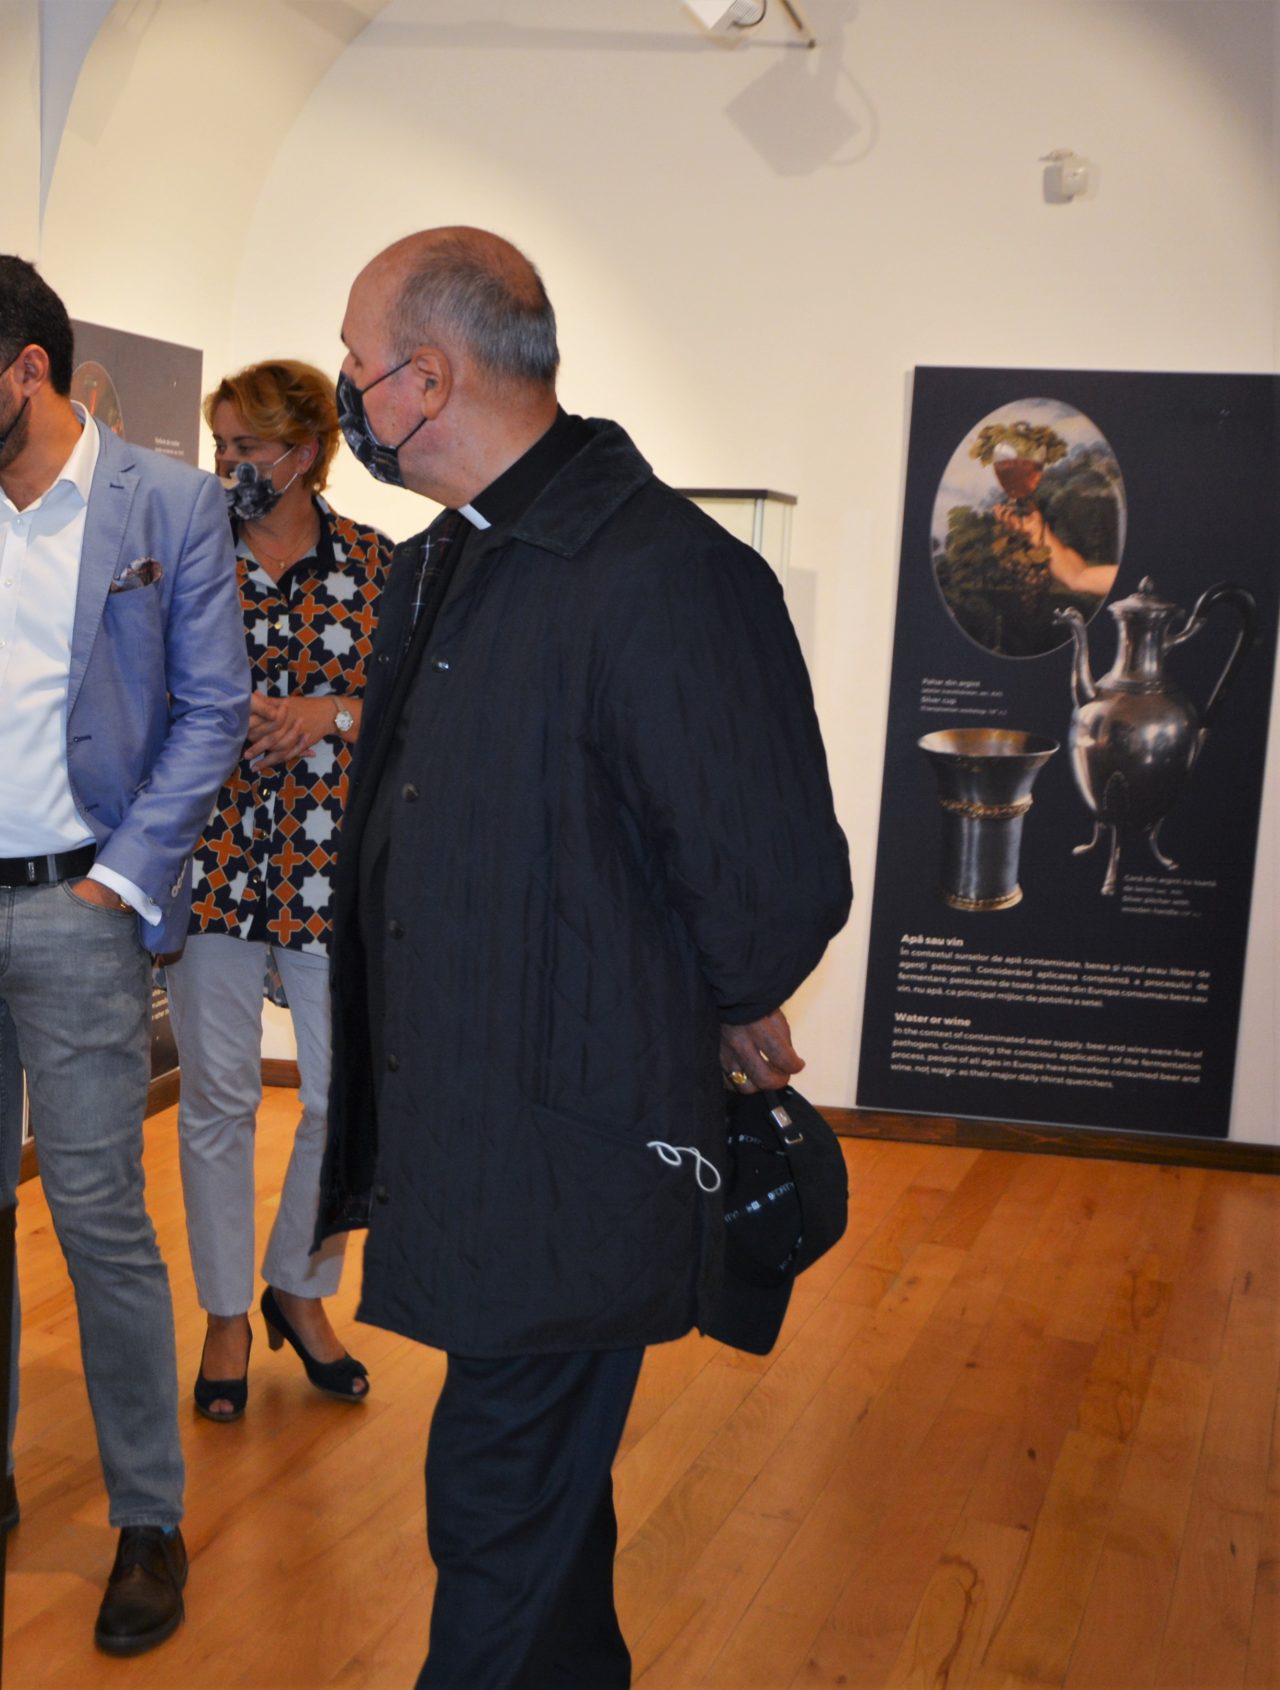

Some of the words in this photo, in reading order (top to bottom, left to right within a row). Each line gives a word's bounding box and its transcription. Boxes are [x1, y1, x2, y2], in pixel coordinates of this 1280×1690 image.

[925, 936, 945, 946] sau
[946, 937, 964, 947] vin
[991, 954, 1003, 962] de
[894, 1012, 928, 1024] Water
[930, 1016, 942, 1024] or
[944, 1016, 971, 1027] wine
[904, 1027, 918, 1035] the
[919, 1029, 952, 1038] context
[953, 1031, 963, 1039] of
[964, 1033, 1026, 1044] contaminated
[1027, 1038, 1052, 1046] water
[1108, 1044, 1125, 1052] and
[942, 1042, 995, 1055] Considering
[997, 1047, 1012, 1055] the
[1013, 1049, 1057, 1059] conscious
[1123, 1057, 1139, 1065] the
[927, 1054, 958, 1063] people
[982, 1059, 1001, 1067] ages
[1012, 1060, 1044, 1070] Europe
[1181, 1075, 1200, 1083] and
[969, 1069, 990, 1077] their
[991, 1071, 1016, 1080] major
[1017, 1073, 1039, 1083] daily
